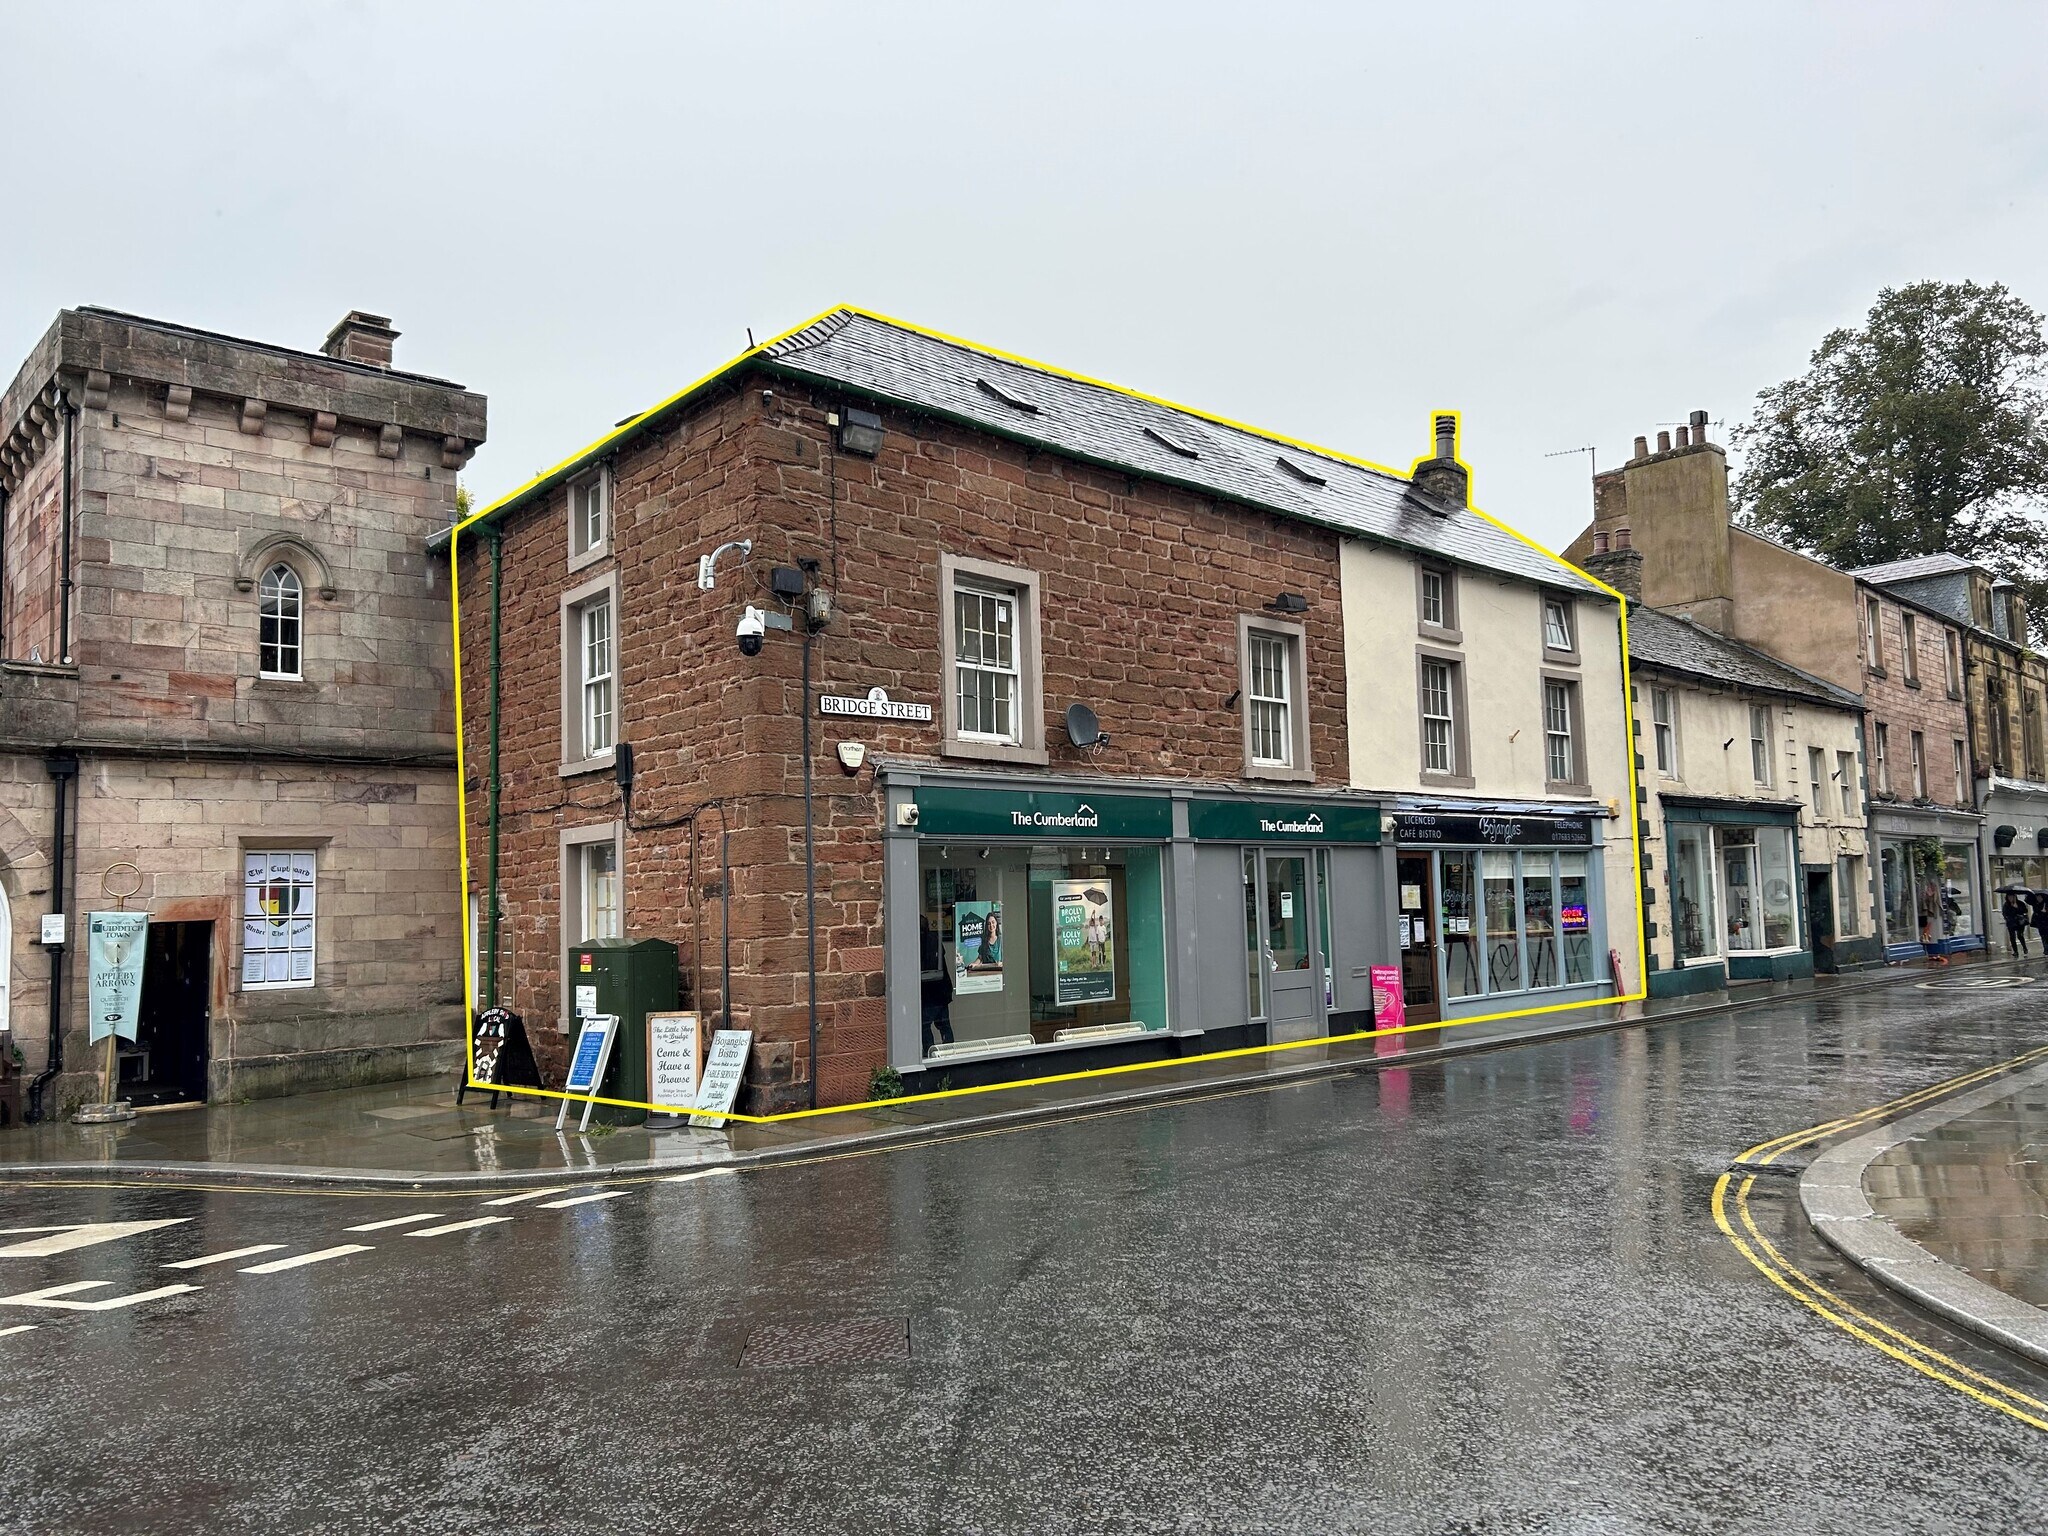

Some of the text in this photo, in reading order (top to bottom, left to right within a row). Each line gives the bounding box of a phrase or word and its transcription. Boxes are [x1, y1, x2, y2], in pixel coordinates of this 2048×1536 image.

[823, 697, 930, 719] BRIDGE STREET
[1010, 811, 1098, 827] The Cumberland
[1404, 815, 1436, 825] LICENCED
[1260, 819, 1324, 833] The Cumberland
[1478, 816, 1521, 844] Bojangles
[1553, 820, 1584, 830] TELEPHONE
[1399, 826, 1442, 839] CAFÉ BISTRO
[247, 868, 264, 877] The
[1061, 907, 1083, 917] BROLLY
[1562, 909, 1582, 917] OPEN
[1065, 915, 1081, 924] DAYS
[92, 924, 144, 933] QUIDDITCH
[961, 922, 983, 932] HOME
[1062, 931, 1081, 939] LOLLY
[1064, 938, 1080, 947] DAYS
[95, 971, 137, 981] APPLEBY
[95, 979, 136, 988] ARROWS
[664, 1025, 679, 1033] Little
[680, 1025, 695, 1034] Shop
[669, 1033, 689, 1041] Bridge
[715, 1035, 748, 1048] Bojangles
[656, 1046, 691, 1058] Come &
[717, 1048, 739, 1058] Bistro
[656, 1060, 691, 1072] Have a
[657, 1073, 690, 1084] Browse
